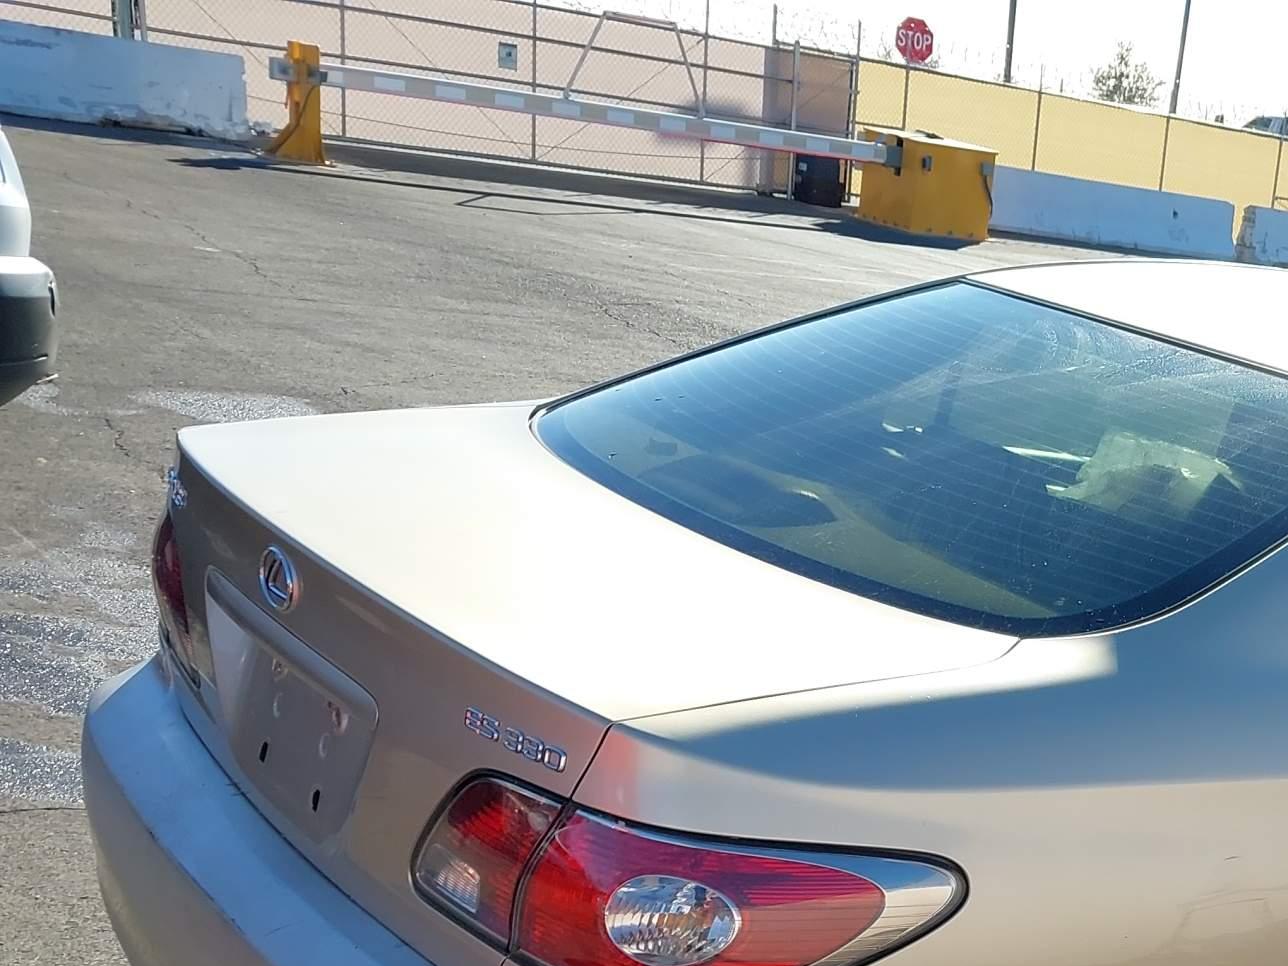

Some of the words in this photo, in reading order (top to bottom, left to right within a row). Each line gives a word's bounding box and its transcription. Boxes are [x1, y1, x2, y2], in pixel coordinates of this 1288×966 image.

[898, 29, 932, 52] STOP
[464, 706, 500, 742] ES
[503, 726, 568, 773] 330
